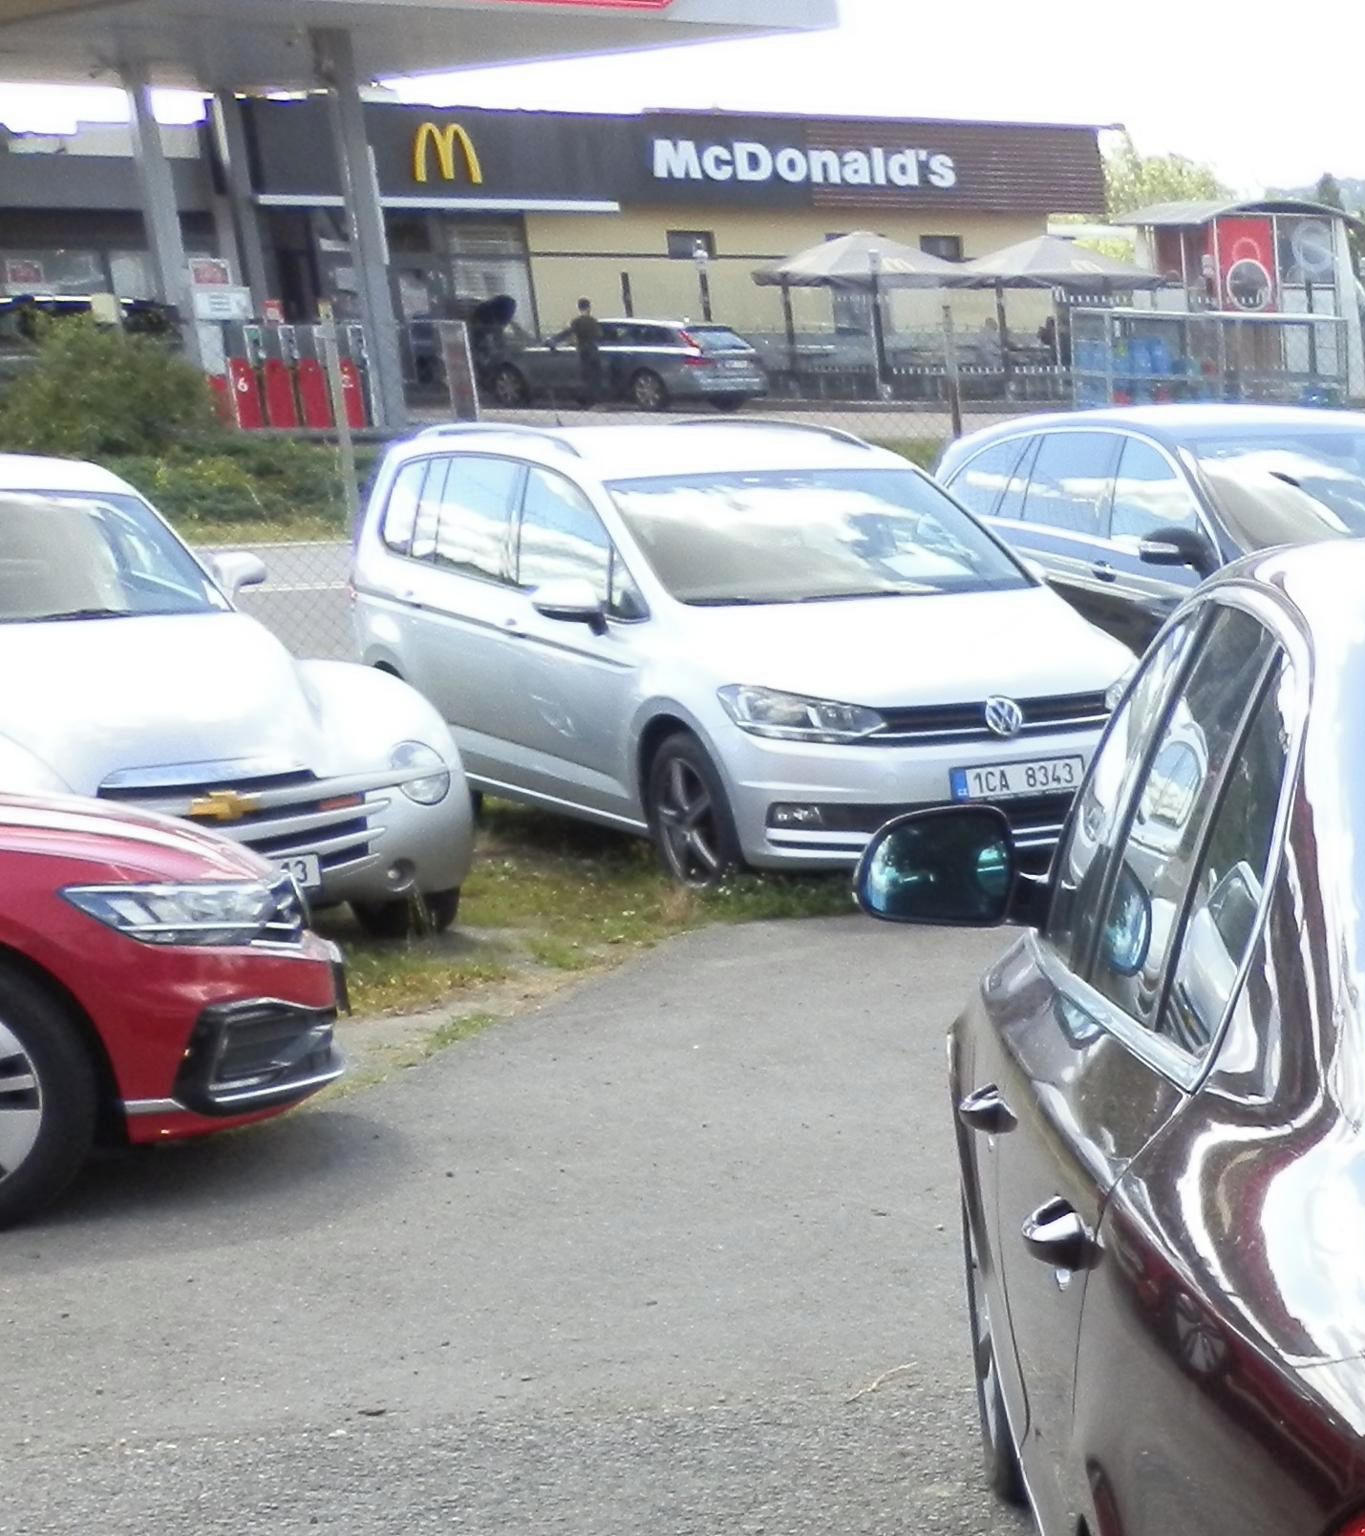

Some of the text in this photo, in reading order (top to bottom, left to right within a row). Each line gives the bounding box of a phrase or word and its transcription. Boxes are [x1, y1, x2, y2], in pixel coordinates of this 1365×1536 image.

[653, 138, 956, 188] McDonald's
[973, 763, 1074, 794] 1CA 8343
